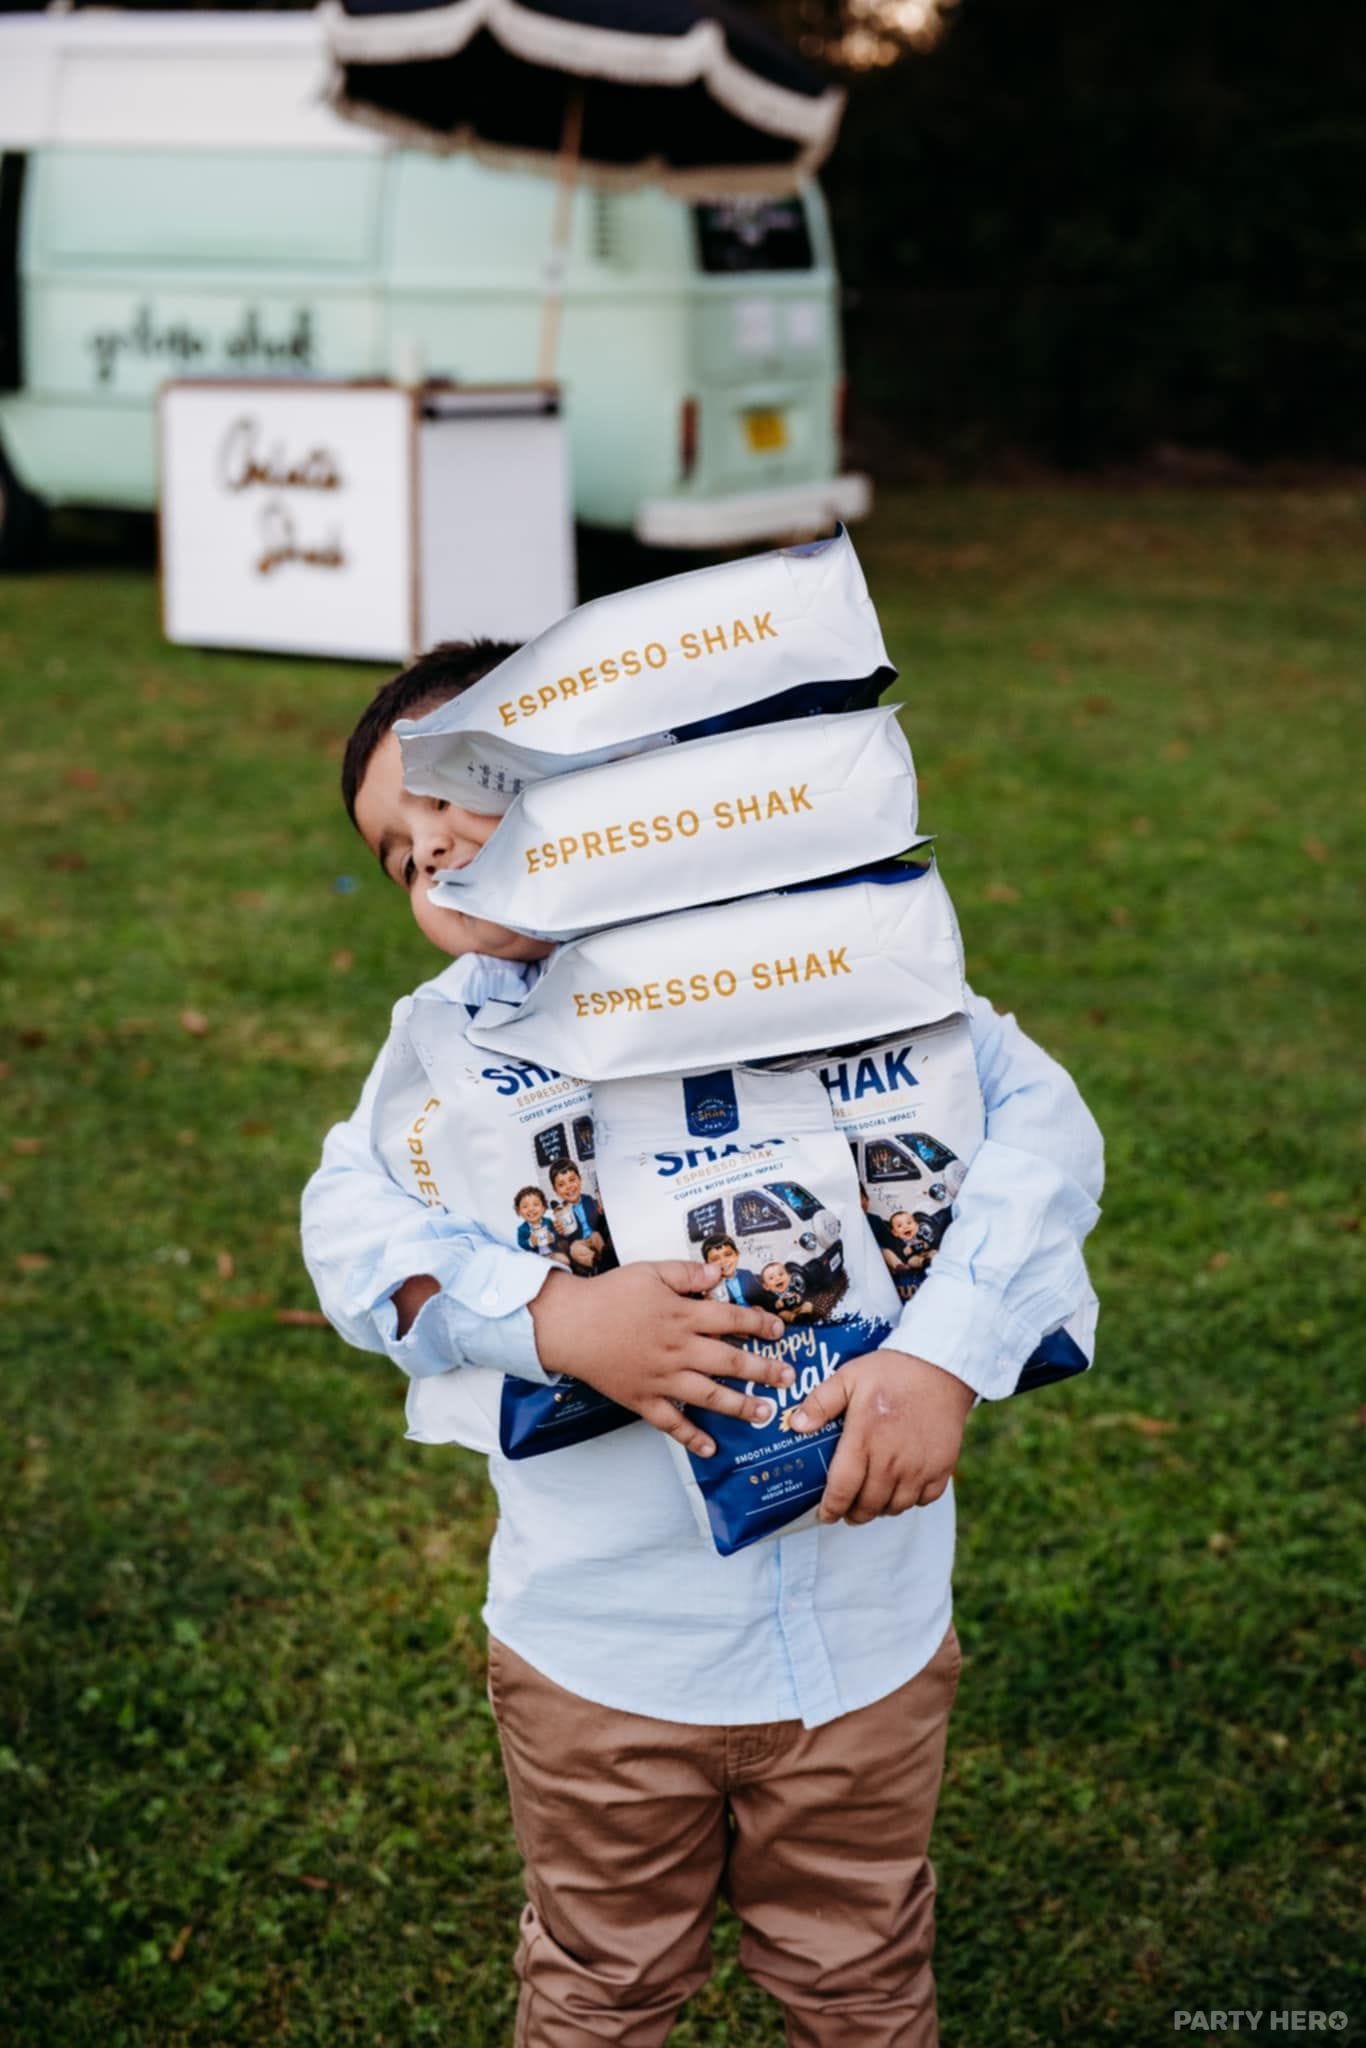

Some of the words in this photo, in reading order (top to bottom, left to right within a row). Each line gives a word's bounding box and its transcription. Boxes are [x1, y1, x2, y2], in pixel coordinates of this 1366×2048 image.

[497, 641, 668, 728] ESPRESSO
[679, 611, 779, 660] SHAK
[525, 809, 701, 874] ESPRESSO
[713, 783, 814, 830] SHAK
[573, 968, 738, 1018] ESPRESSO
[751, 946, 853, 992] SHAK
[516, 1080, 570, 1108] ESPRESSO
[819, 1046, 919, 1101] HAK
